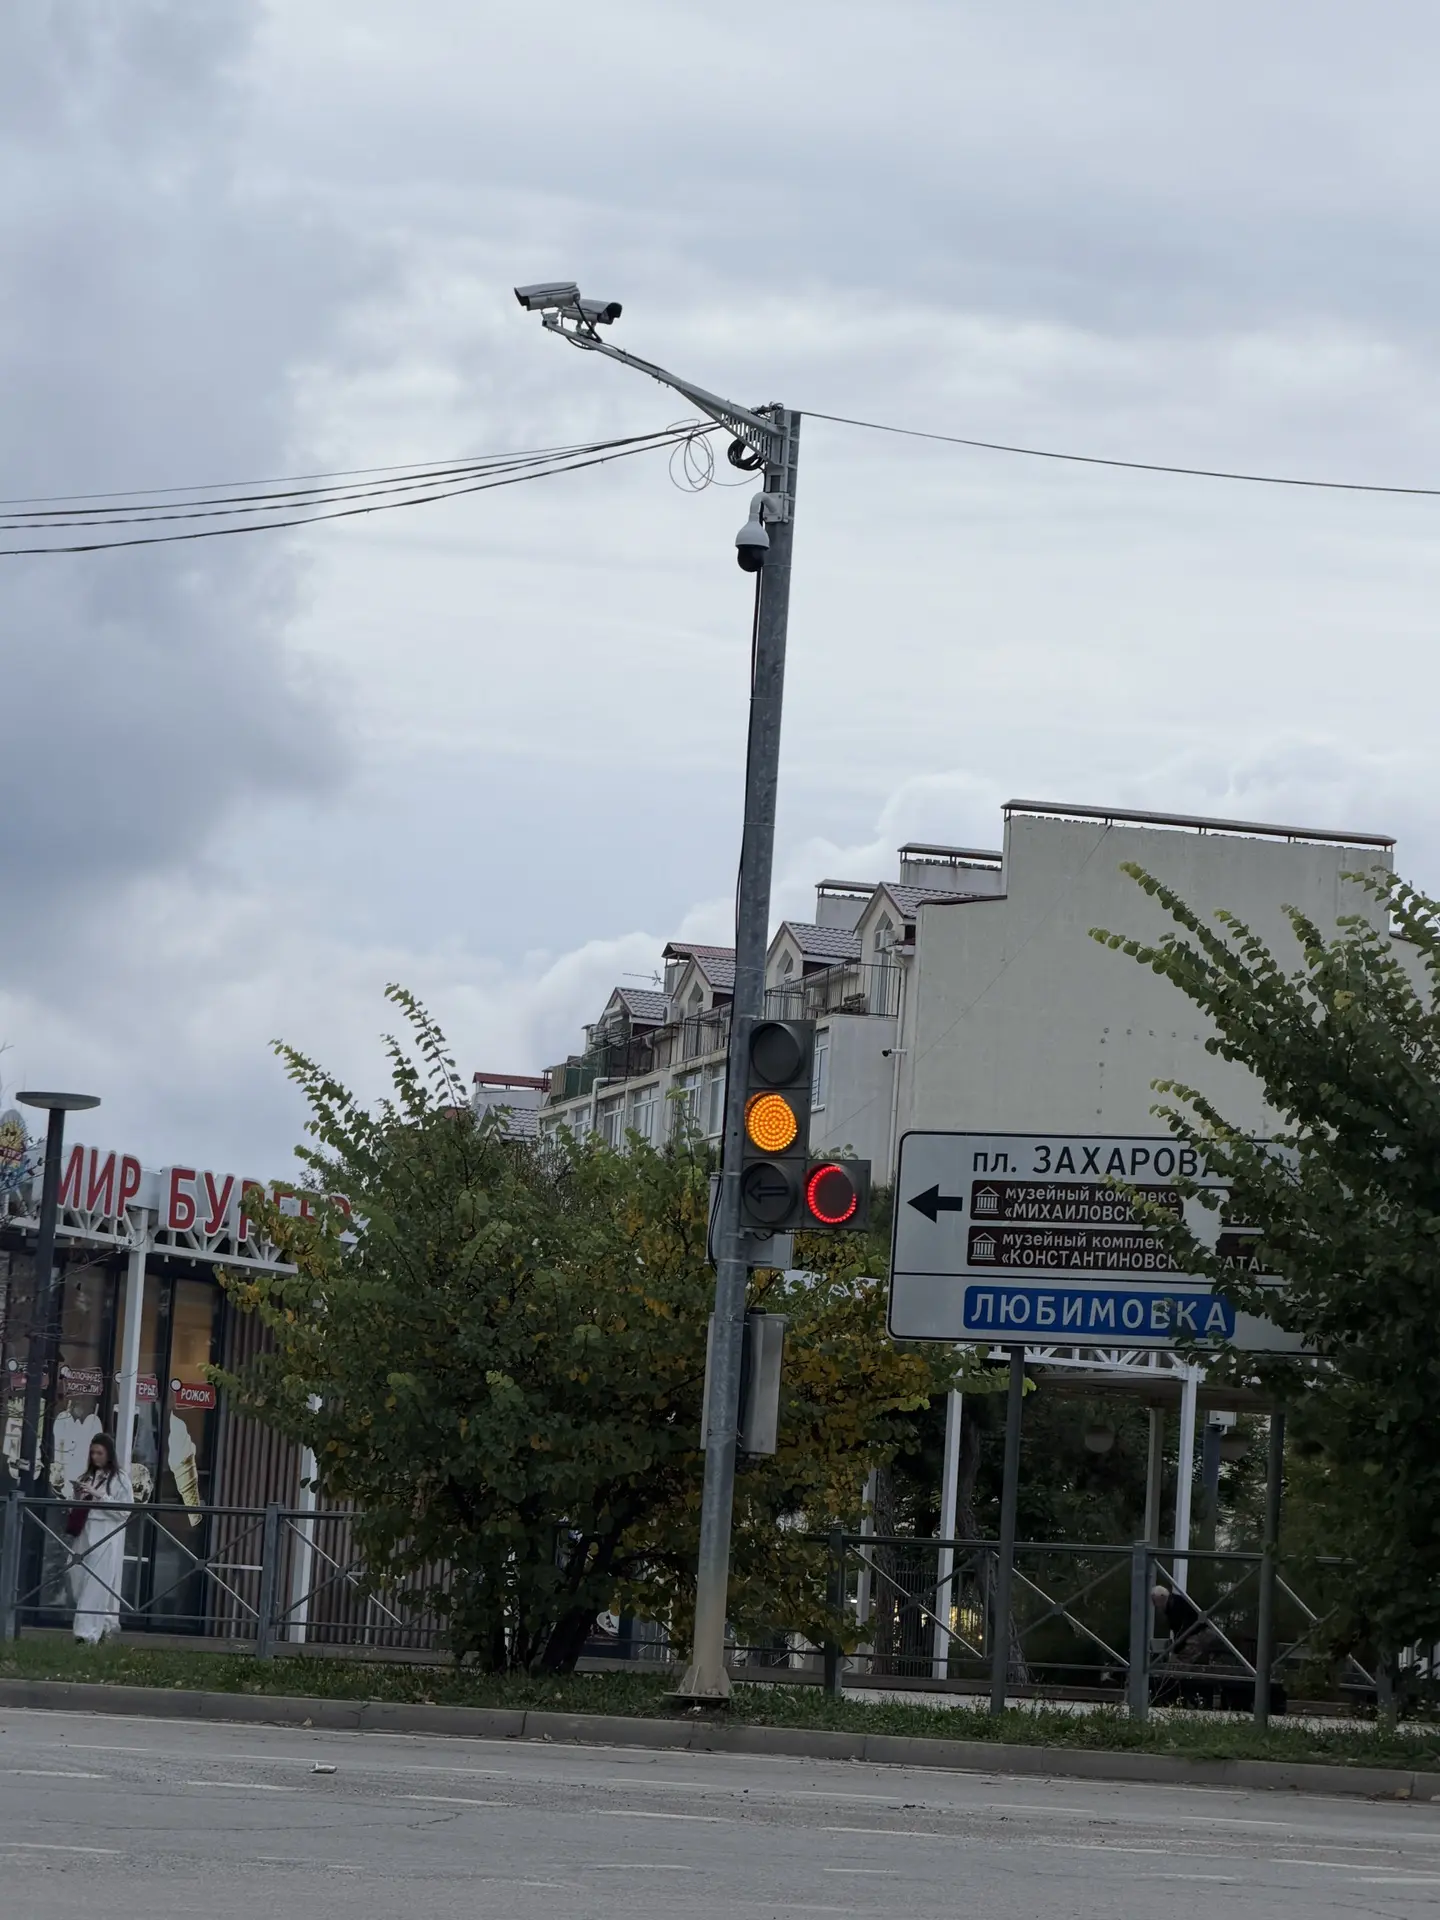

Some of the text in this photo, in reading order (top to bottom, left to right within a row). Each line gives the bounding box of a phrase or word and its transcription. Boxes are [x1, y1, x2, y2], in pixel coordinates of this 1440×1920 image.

[973, 1152, 1017, 1173] пл.
[1005, 1185, 1090, 1202] музейный
[1004, 1203, 1158, 1222] «МИХАИЛОВСК
[1002, 1231, 1174, 1250] музейный комплек
[1001, 1249, 1190, 1270] «КОНСТАНТИНОВСК
[970, 1293, 1228, 1332] ЛЮБИМОВКА
[180, 1388, 211, 1402] РОЖОК
